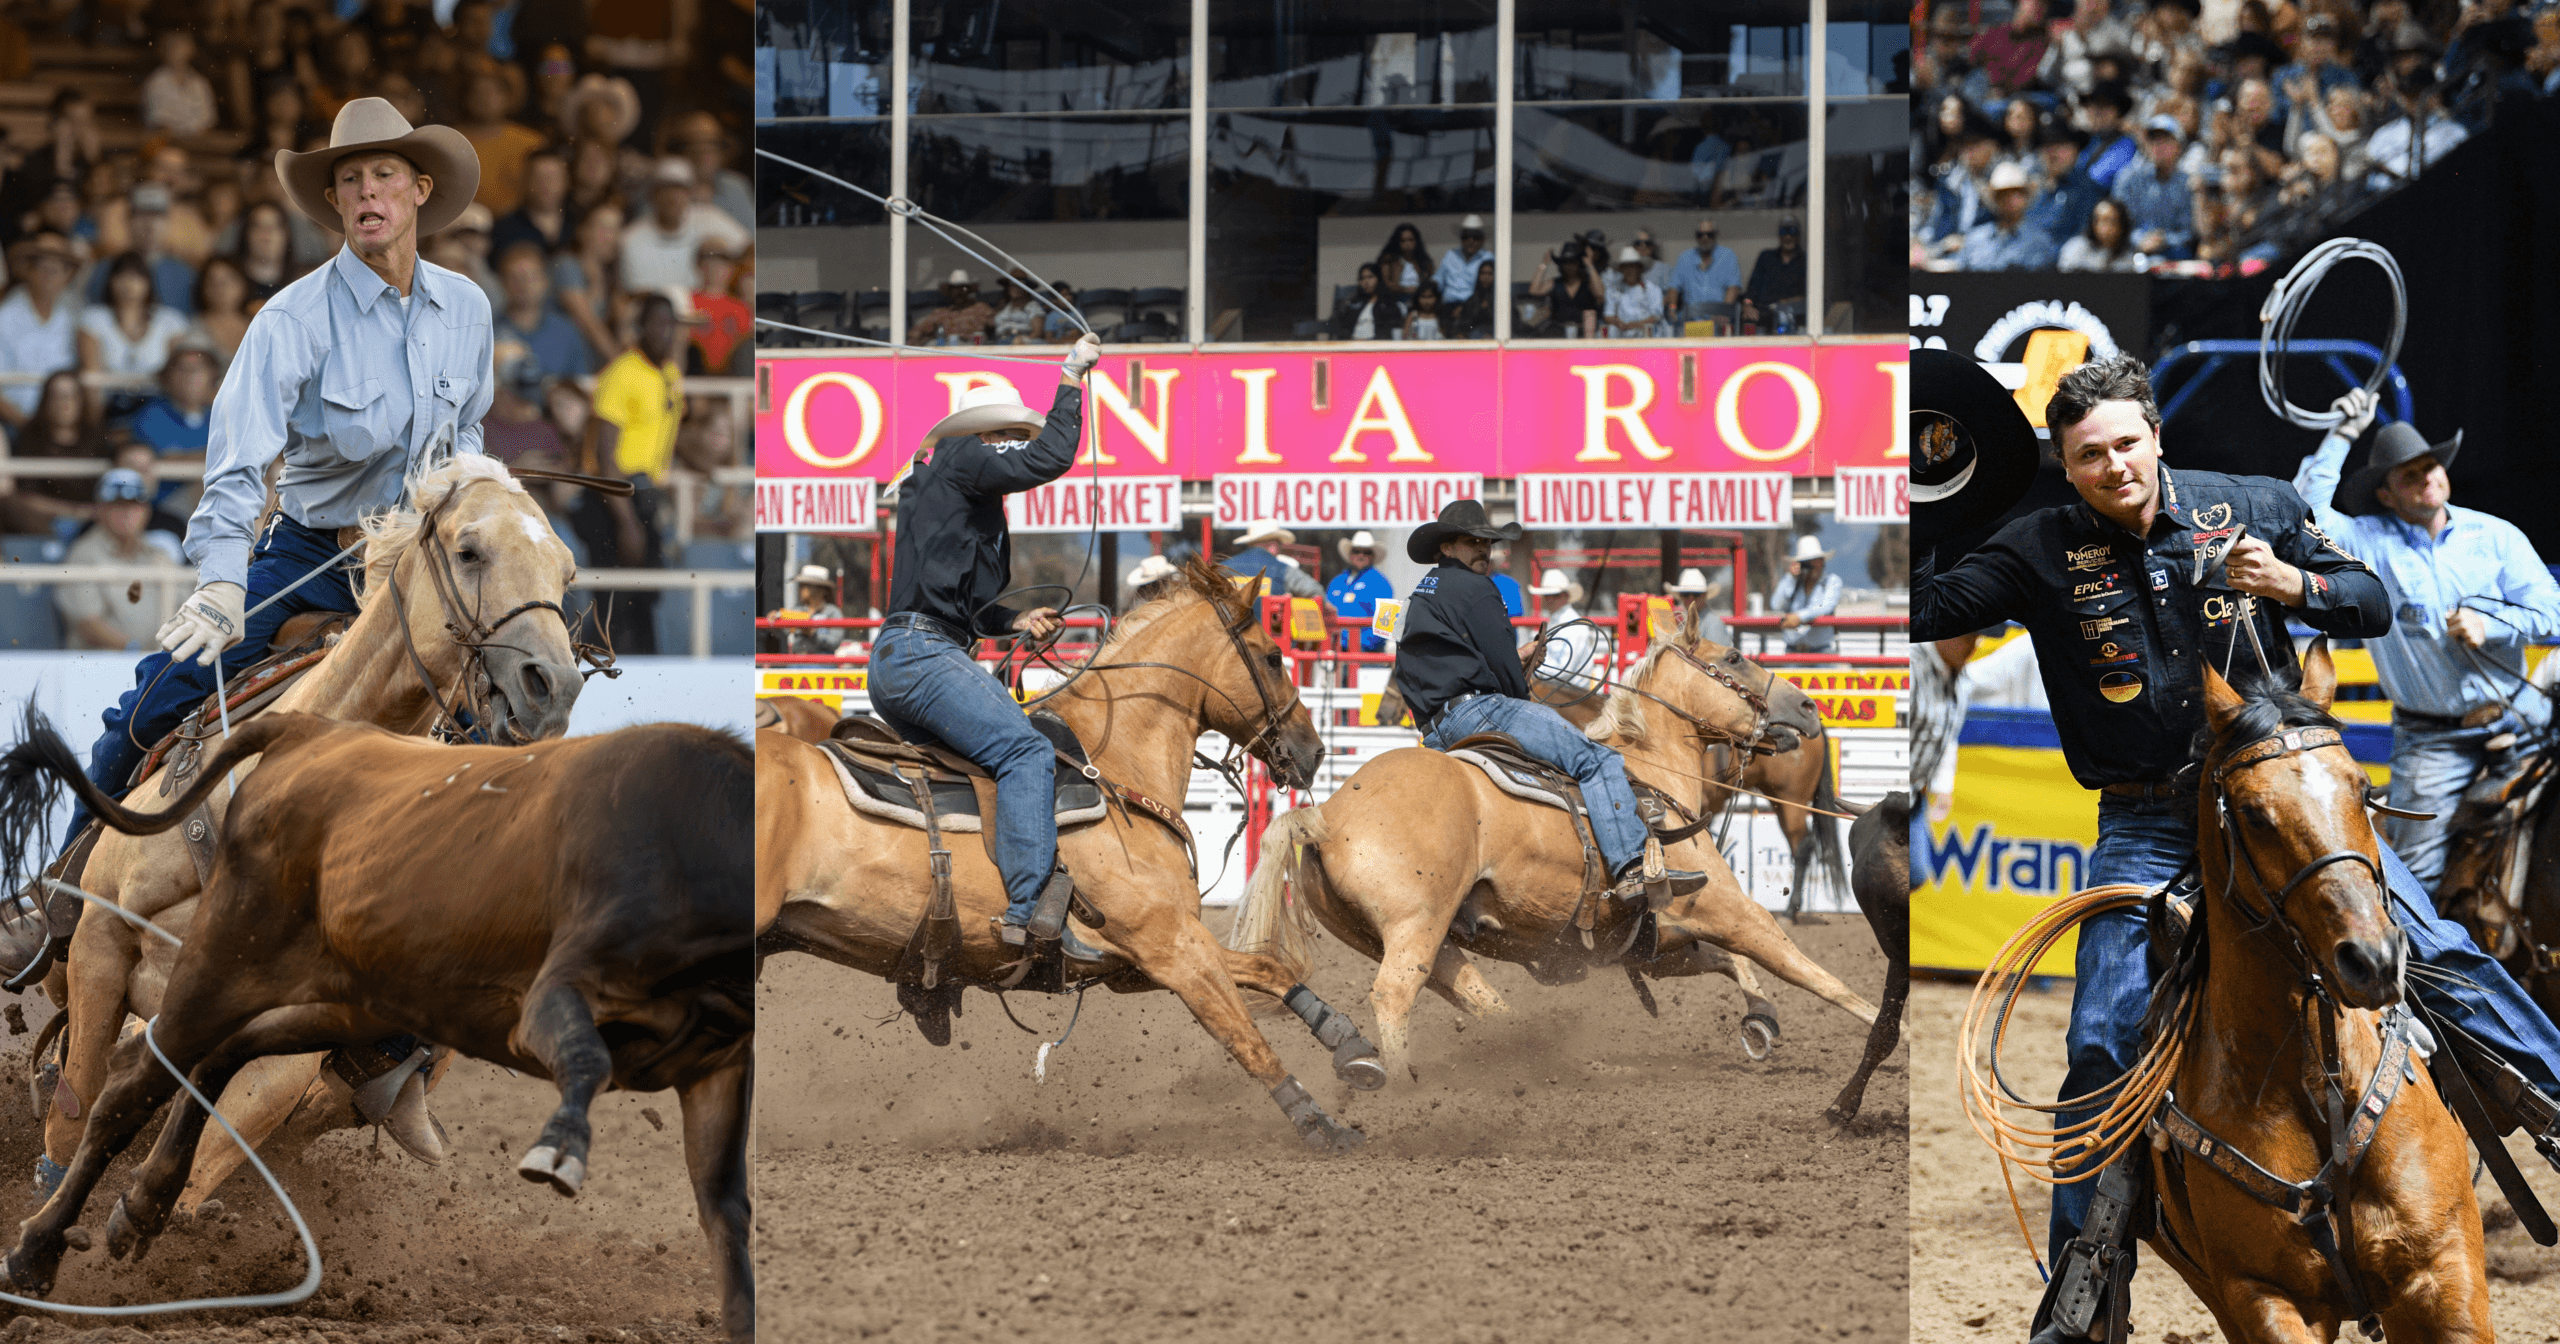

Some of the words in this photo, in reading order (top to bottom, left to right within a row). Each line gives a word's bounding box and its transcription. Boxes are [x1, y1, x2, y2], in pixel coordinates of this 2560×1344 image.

[783, 365, 1434, 469] ONIA
[792, 484, 868, 525] FAMILY
[1025, 482, 1173, 526] MARKET
[1219, 480, 1348, 522] SILACCI
[1523, 479, 1655, 523] LINDLEY
[1669, 478, 1784, 523] FAMILY
[1841, 474, 1886, 517] TIM
[2065, 545, 2111, 562] POMEROY
[1417, 576, 1439, 586] VS
[2074, 581, 2104, 595] EPIC
[2204, 593, 2256, 620] Claic
[1141, 796, 1171, 819] CVS
[1926, 826, 2096, 893] Wran
